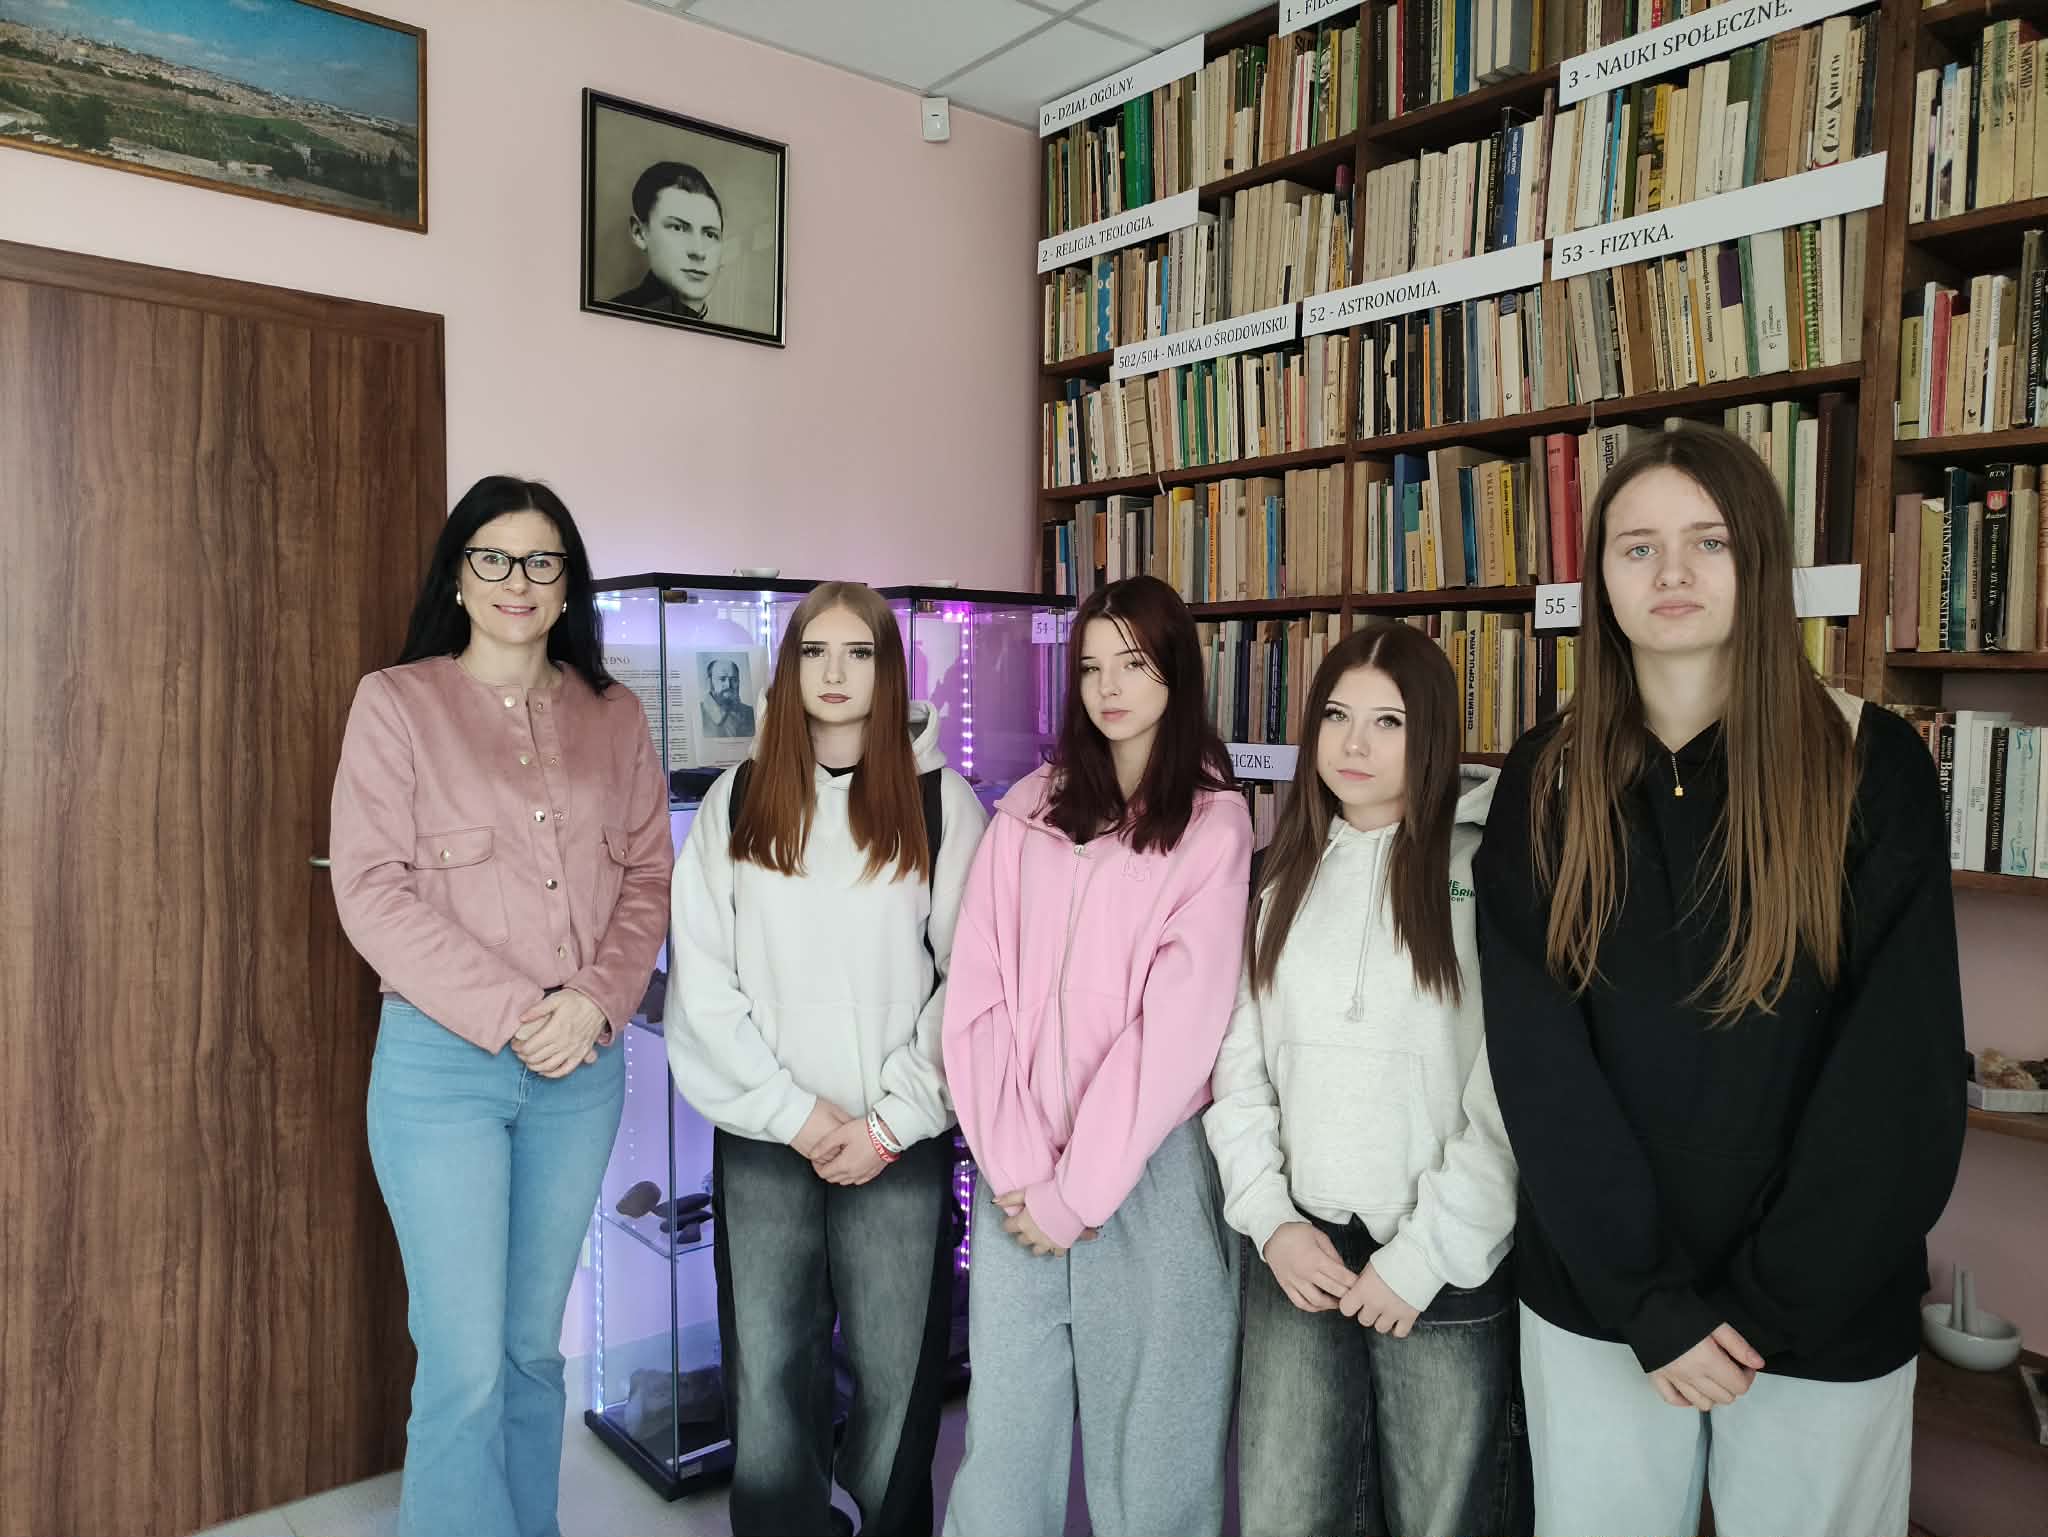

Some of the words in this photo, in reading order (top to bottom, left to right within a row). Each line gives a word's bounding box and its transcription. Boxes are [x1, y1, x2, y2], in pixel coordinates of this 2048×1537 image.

[1568, 71, 1579, 89] 3
[1597, 43, 1657, 79] NAUKI
[1663, 2, 1793, 56] SPOŁECZNE.
[1044, 113, 1050, 126] 0
[1058, 97, 1088, 121] DZIAŁ
[1090, 77, 1134, 106] OGÓLNY.
[1042, 250, 1048, 263] 2
[1056, 235, 1097, 258] RELIGIA.
[1099, 215, 1155, 243] TEOLOGIA.
[1561, 244, 1583, 264] 53
[1600, 224, 1674, 256] FIZYKA.
[1310, 306, 1326, 323] 52
[1337, 279, 1442, 317] ASTRONOMIA.
[1119, 348, 1159, 369] 502/504
[1167, 340, 1202, 358] NAUKA
[1204, 335, 1212, 348] O
[1214, 315, 1289, 346] ŚRODOWISKU.
[1545, 598, 1565, 614] 55
[1468, 629, 1476, 689] POPULARNA
[1467, 691, 1475, 730] CHEMIA
[1940, 761, 1953, 793] Batyr
[1451, 888, 1476, 897] DRI
